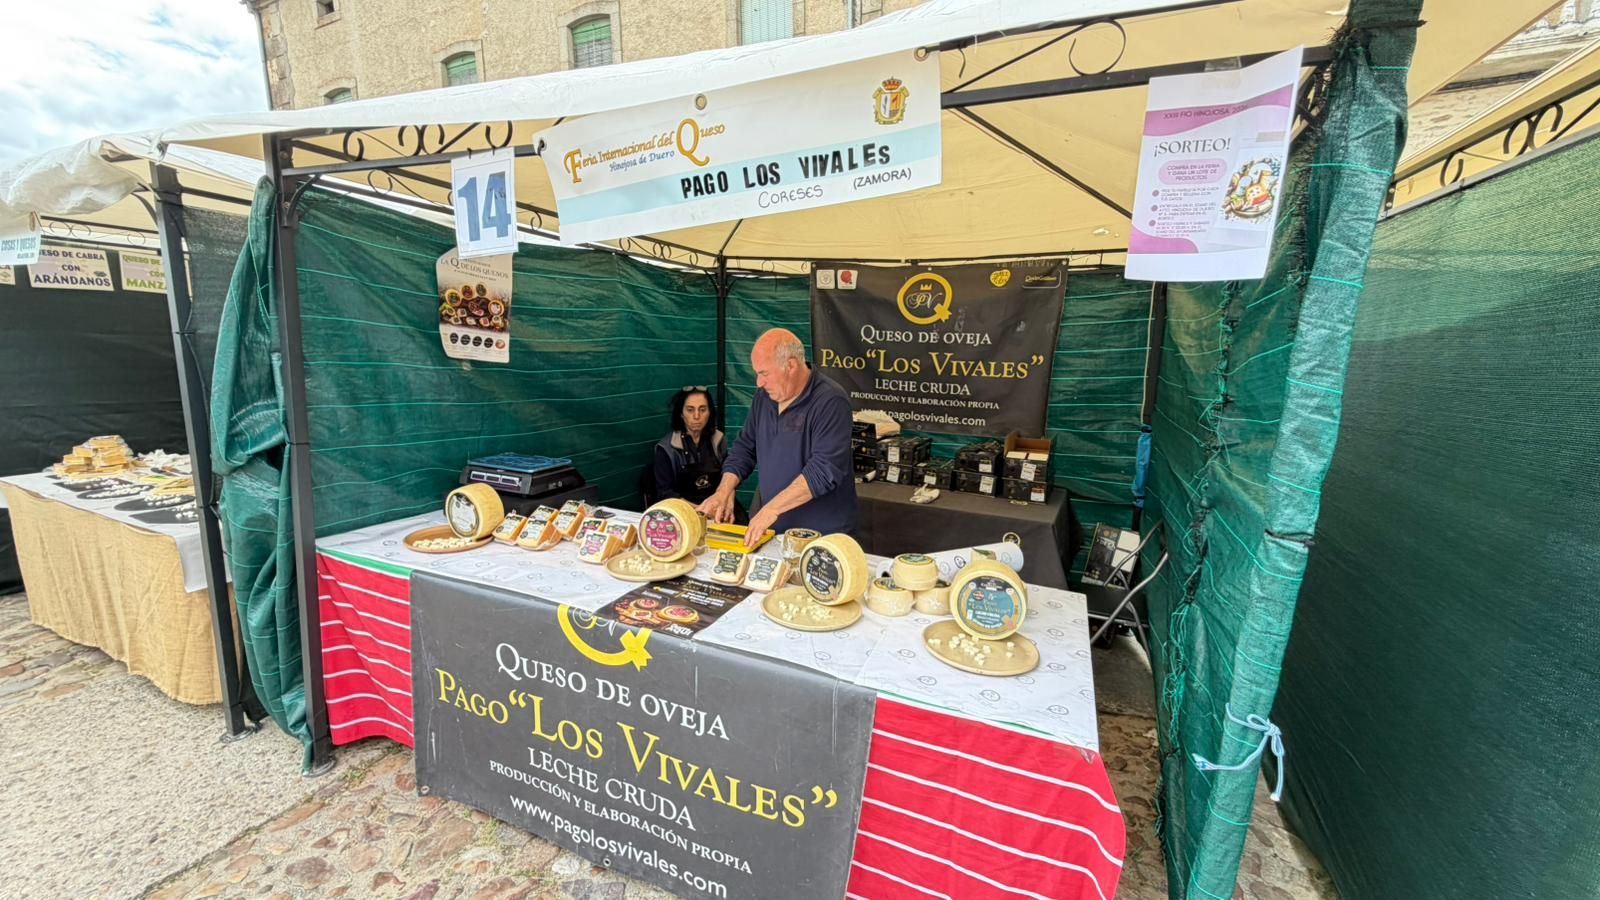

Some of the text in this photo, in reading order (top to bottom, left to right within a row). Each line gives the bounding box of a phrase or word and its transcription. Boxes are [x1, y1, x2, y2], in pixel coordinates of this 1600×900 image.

[563, 118, 725, 184] Feria Internacional del Queso
[1154, 138, 1231, 157] ¡SORTEO!
[609, 150, 675, 172] Hinojosa de Duero
[680, 143, 891, 199] PAGO LOS VIVALES
[853, 168, 912, 190] (ZAMORA)
[458, 171, 512, 242] 14
[758, 185, 824, 208] CORESES
[76, 252, 104, 261] CABRA
[62, 264, 81, 272] CON
[34, 273, 111, 287] ARÁNDANOS
[126, 278, 167, 290] MANZ
[860, 324, 992, 347] QUESO DE OVEJA
[820, 348, 866, 370] PAGO
[874, 378, 972, 396] LECHE CRUDA
[850, 391, 900, 403] PRODUCCIÓN
[908, 396, 966, 408] ELABORACIÓN
[968, 401, 1000, 410] PROPIA
[860, 408, 986, 426] pagolosvivales.com
[436, 668, 509, 725] PAGO
[496, 643, 730, 741] QUESO DE OVEJA
[528, 747, 697, 831] LECHE CRUDA
[488, 760, 752, 874] PRODUCCIÓN Y ELABORACIÓN PROPIA
[510, 795, 728, 898] www.pagolosvivales.com
